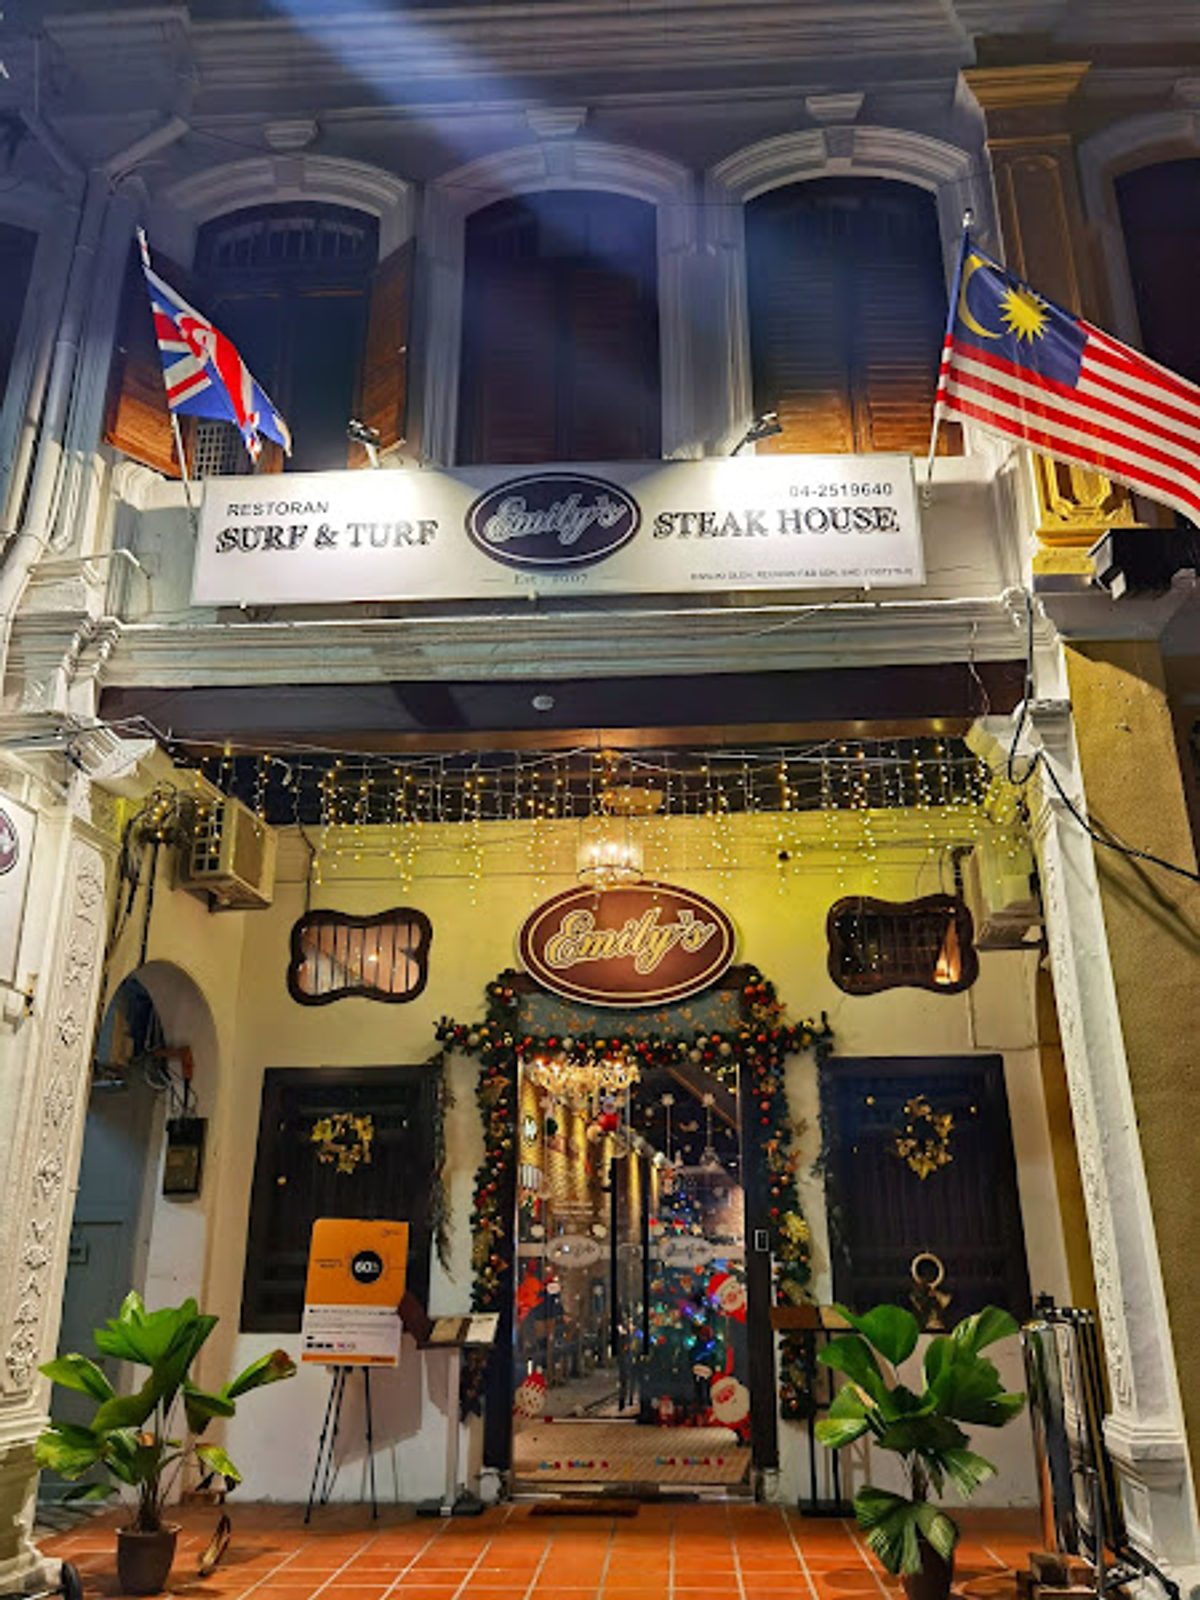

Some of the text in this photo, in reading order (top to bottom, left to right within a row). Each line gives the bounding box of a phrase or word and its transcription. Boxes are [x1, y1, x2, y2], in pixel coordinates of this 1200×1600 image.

[789, 482, 893, 498] 04-2519640
[226, 501, 330, 517] RESTORAN
[483, 493, 628, 546] Emily's
[653, 506, 901, 540] STEAK HOUSE
[216, 519, 440, 553] SURF & TURF
[544, 908, 718, 975] Emily's
